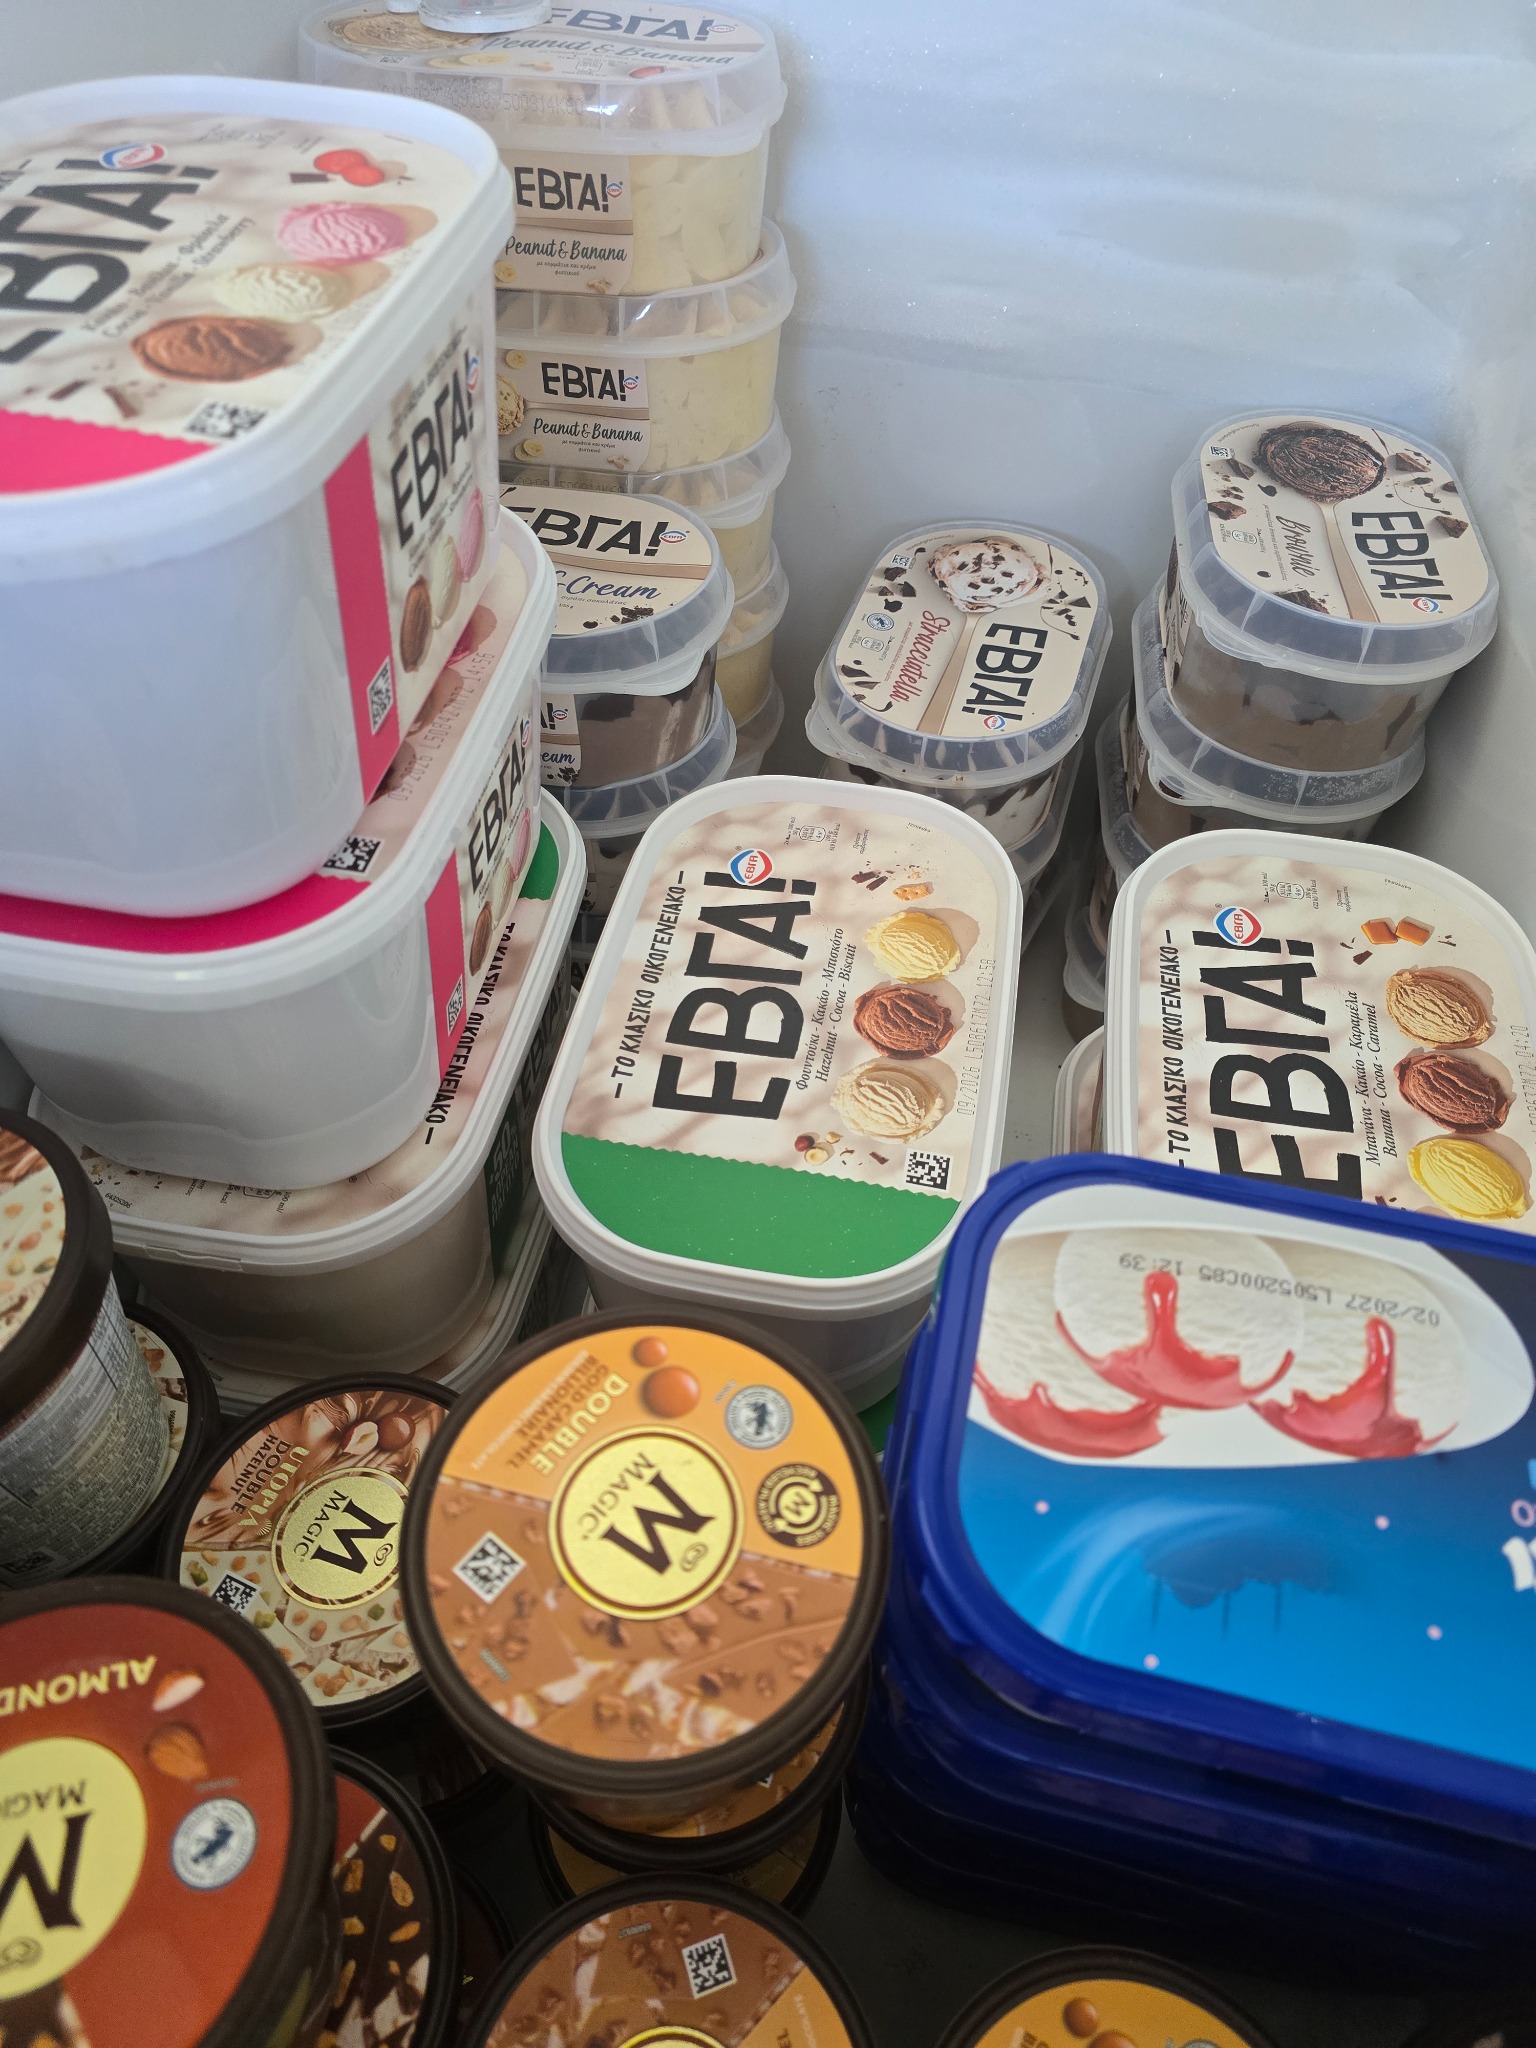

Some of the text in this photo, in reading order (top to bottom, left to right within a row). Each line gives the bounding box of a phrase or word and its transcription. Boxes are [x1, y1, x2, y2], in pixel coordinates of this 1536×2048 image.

[480, 35, 594, 51] Peanut
[613, 46, 736, 64] Banana
[514, 167, 609, 213] ΕΒΓΑ!
[0, 159, 219, 364] ΒΓΑ!
[505, 236, 627, 261] Peanut & Banana
[541, 362, 627, 401] ΕΒΓΑ!
[533, 418, 643, 442] Peanut & Banana
[1275, 515, 1320, 578] Brownie
[1352, 511, 1453, 601] ΕΒΓΑ!
[566, 575, 661, 600] Cream
[889, 610, 950, 702] Stracciatella
[961, 622, 1048, 721] ΕΒΓΑ!
[540, 751, 575, 765] eam
[468, 719, 526, 895] ΕΒΓΑ!
[611, 886, 687, 1078] ΤΟ ΚΛΑΣΙΚΟ ΟΙΚΟΓΕΝΕΙΑΚΟ
[653, 870, 817, 1120] ΕΒΓΑ!
[795, 1032, 820, 1090] Φουντούκι
[811, 989, 830, 1026] Κακάο
[821, 928, 844, 982] Μπισκότο
[815, 1031, 838, 1083] Hazelnut
[828, 990, 847, 1022] Cocoa
[838, 943, 857, 982] Biscuit
[1159, 945, 1191, 1154] ΤΟ ΚΛΑΣΙΚΟ ΟΙΚΟΓΕΝΕΙΑΚΟ
[1345, 990, 1364, 1051] Καραμέλα
[1366, 1002, 1382, 1053] Caramel
[956, 1066, 981, 1116] 09/2026
[1192, 930, 1362, 1200] ΕΒΓΑ!
[1355, 1058, 1370, 1099] Κακάο
[1372, 1059, 1388, 1099] Cocoa
[1364, 1106, 1381, 1167] Μπανάνα
[1376, 1110, 1398, 1159] Banana
[1198, 1262, 1333, 1306] L505200C85
[1344, 1296, 1441, 1329] 02/2027
[571, 1363, 611, 1405] GOLD
[505, 1402, 575, 1472] CARAMEL
[528, 1371, 631, 1477] DOUBLE
[230, 1433, 279, 1495] HAZELNUT
[230, 1440, 292, 1515] DOUBLE
[237, 1445, 311, 1528] UTOPIA
[293, 1488, 350, 1558] MAGIC
[577, 1452, 658, 1540] MAGIC
[601, 1471, 717, 1576] M
[311, 1497, 399, 1575] M
[0, 1779, 88, 1820] MAGI
